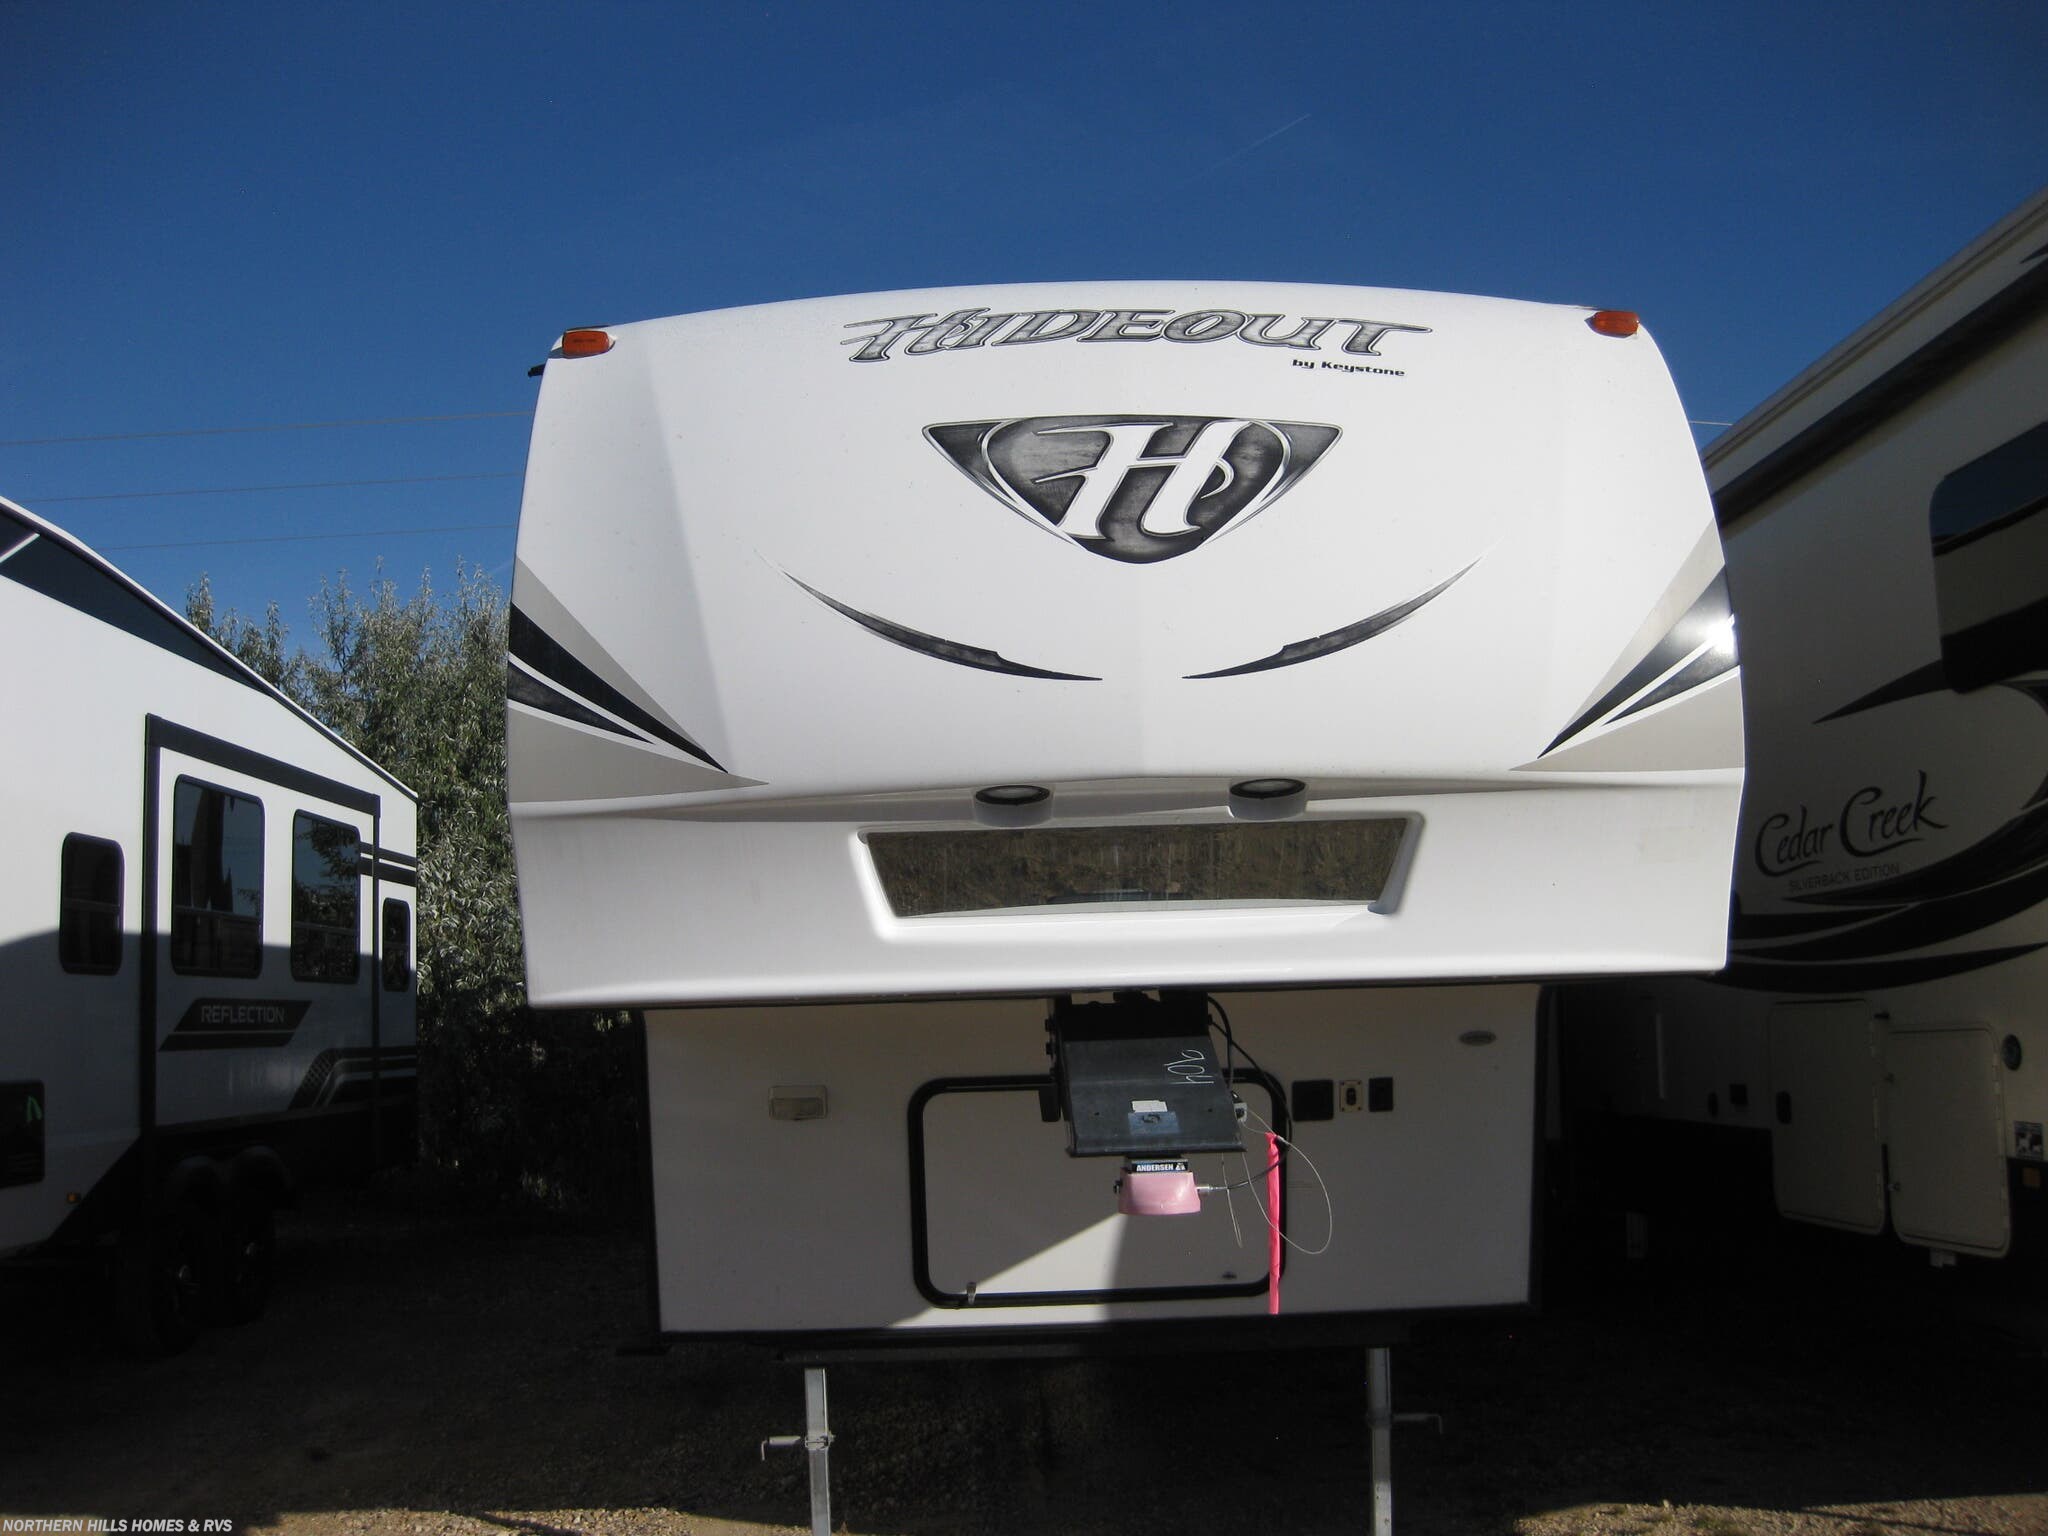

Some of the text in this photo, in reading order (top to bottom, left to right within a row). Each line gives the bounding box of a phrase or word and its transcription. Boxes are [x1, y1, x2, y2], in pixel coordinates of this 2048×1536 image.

[1292, 358, 1405, 376] by Keystone
[1754, 769, 1948, 877] Cedar Creek
[1854, 863, 1900, 881] EDITION
[201, 1005, 285, 1023] REFLECTION
[1136, 1163, 1174, 1172] ANDERSEN
